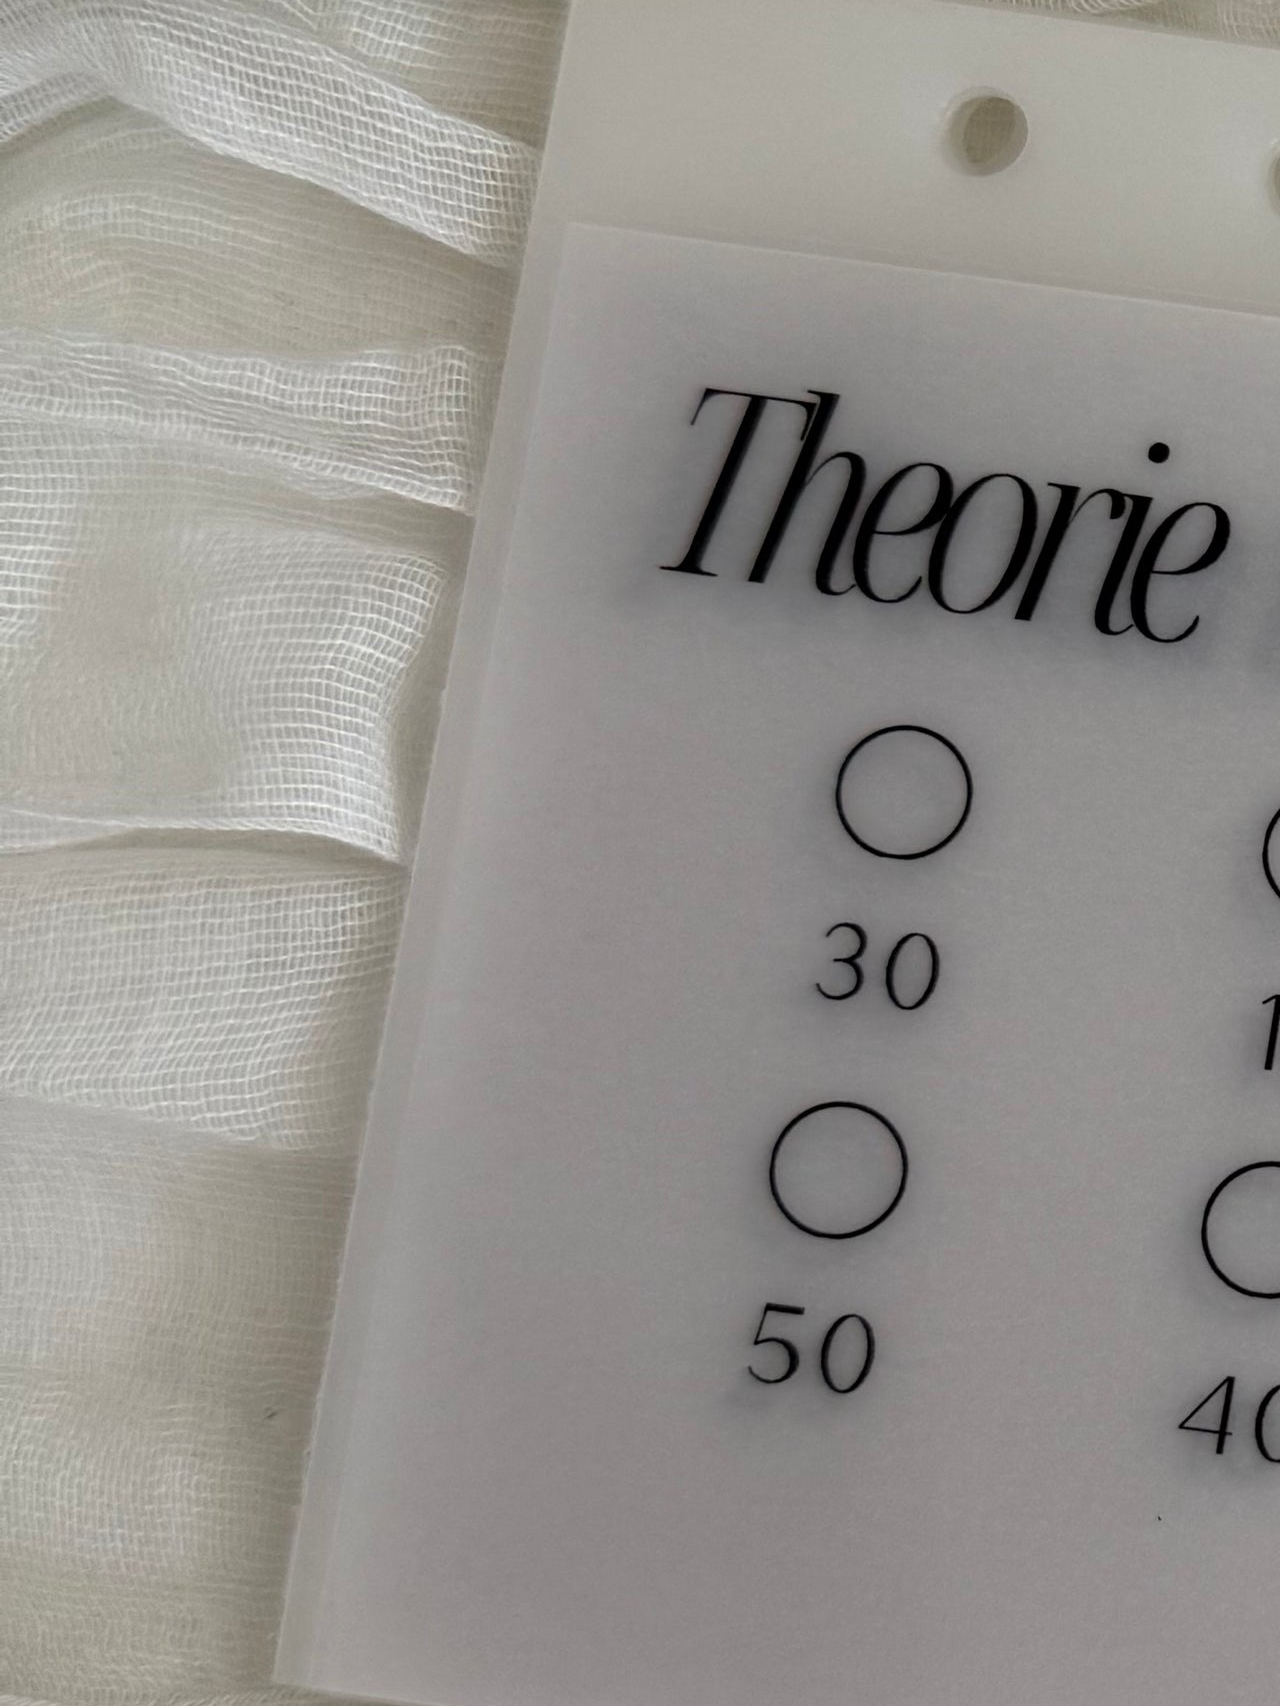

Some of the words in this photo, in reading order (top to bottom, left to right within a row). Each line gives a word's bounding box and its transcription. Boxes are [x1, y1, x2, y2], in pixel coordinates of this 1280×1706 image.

[661, 387, 1231, 644] Theorie
[815, 922, 940, 1011] 30
[750, 1302, 874, 1393] 50
